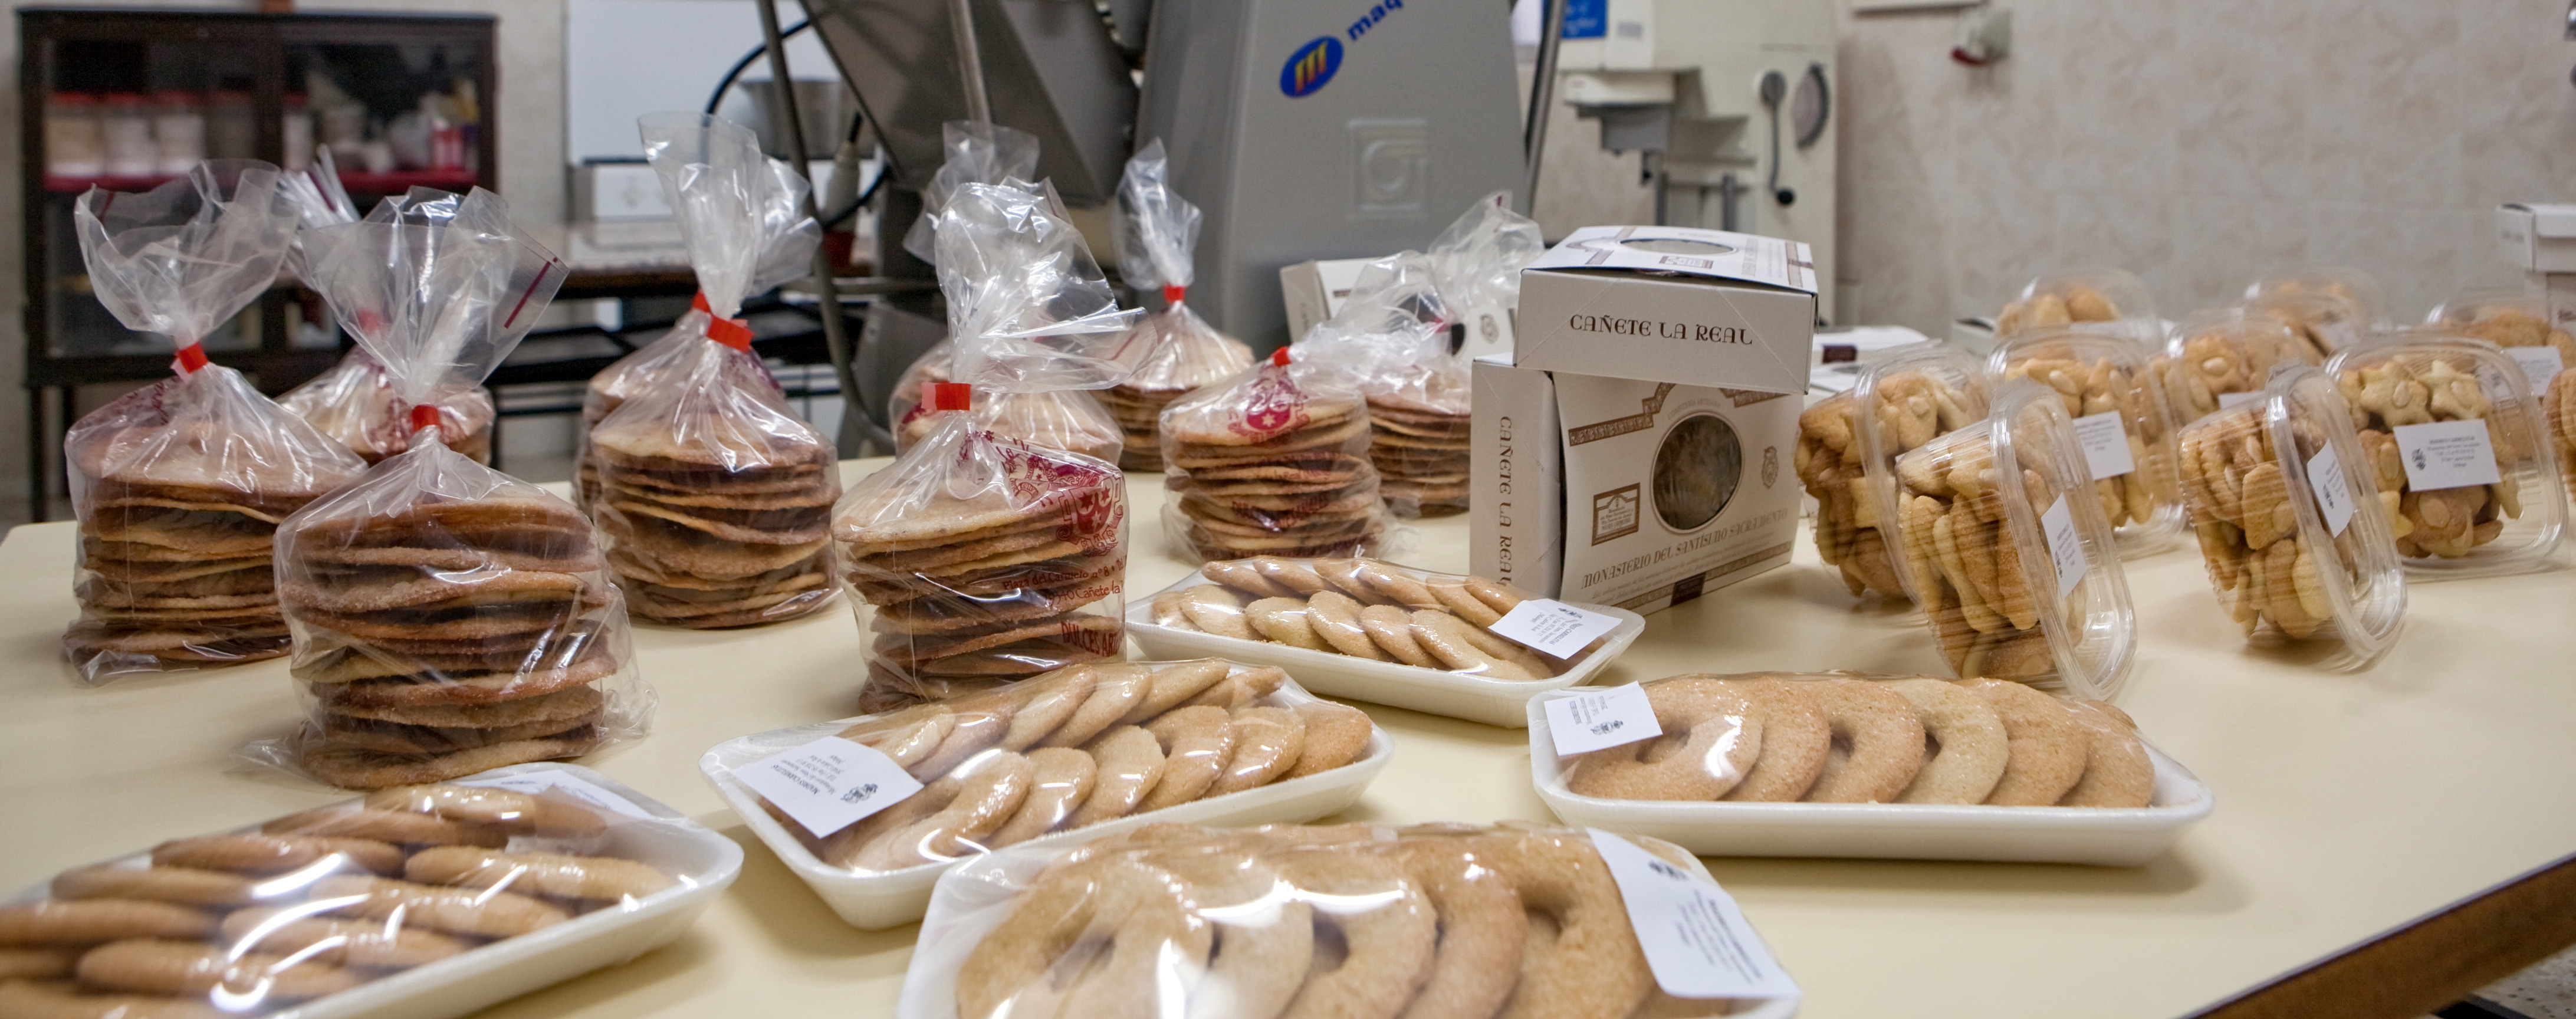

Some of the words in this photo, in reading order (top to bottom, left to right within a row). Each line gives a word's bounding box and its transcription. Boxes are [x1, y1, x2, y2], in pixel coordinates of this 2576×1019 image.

[1569, 313, 1652, 337] CAÑETE
[1658, 321, 1688, 340] LA
[1695, 324, 1753, 346] REAL
[1499, 415, 1514, 495] CAÑETE
[1499, 501, 1513, 528] LA
[1497, 535, 1513, 587] REAL
[1581, 553, 1652, 590] MONASTERIO
[1653, 545, 1674, 564] DEL
[1675, 527, 1728, 557] SANTÍSIMO
[1002, 578, 1030, 590] Plaza
[1031, 573, 1047, 585] del
[1103, 566, 1109, 577] 8
[1075, 584, 1110, 599] Cañete
[1111, 580, 1121, 594] la
[1061, 620, 1100, 656] DULCES
